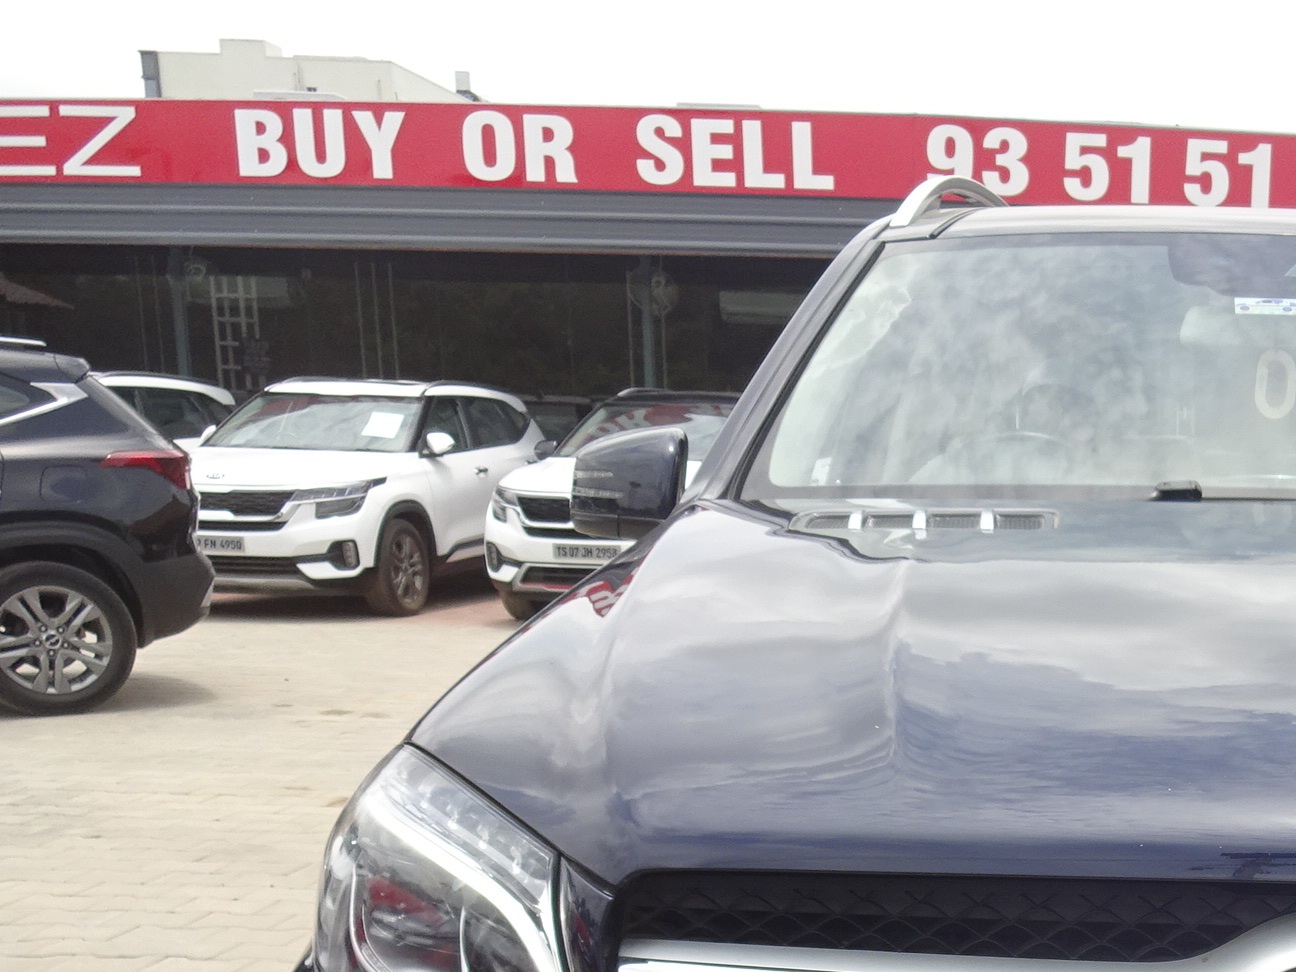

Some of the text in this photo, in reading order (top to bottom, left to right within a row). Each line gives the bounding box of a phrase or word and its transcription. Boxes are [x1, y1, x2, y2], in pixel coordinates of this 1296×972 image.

[233, 109, 406, 179] BUY
[461, 110, 578, 183] OR
[635, 114, 835, 190] SELL
[927, 124, 1029, 197] 93
[1063, 132, 1152, 204] 51
[1183, 138, 1272, 208] 51
[557, 546, 568, 558] TS
